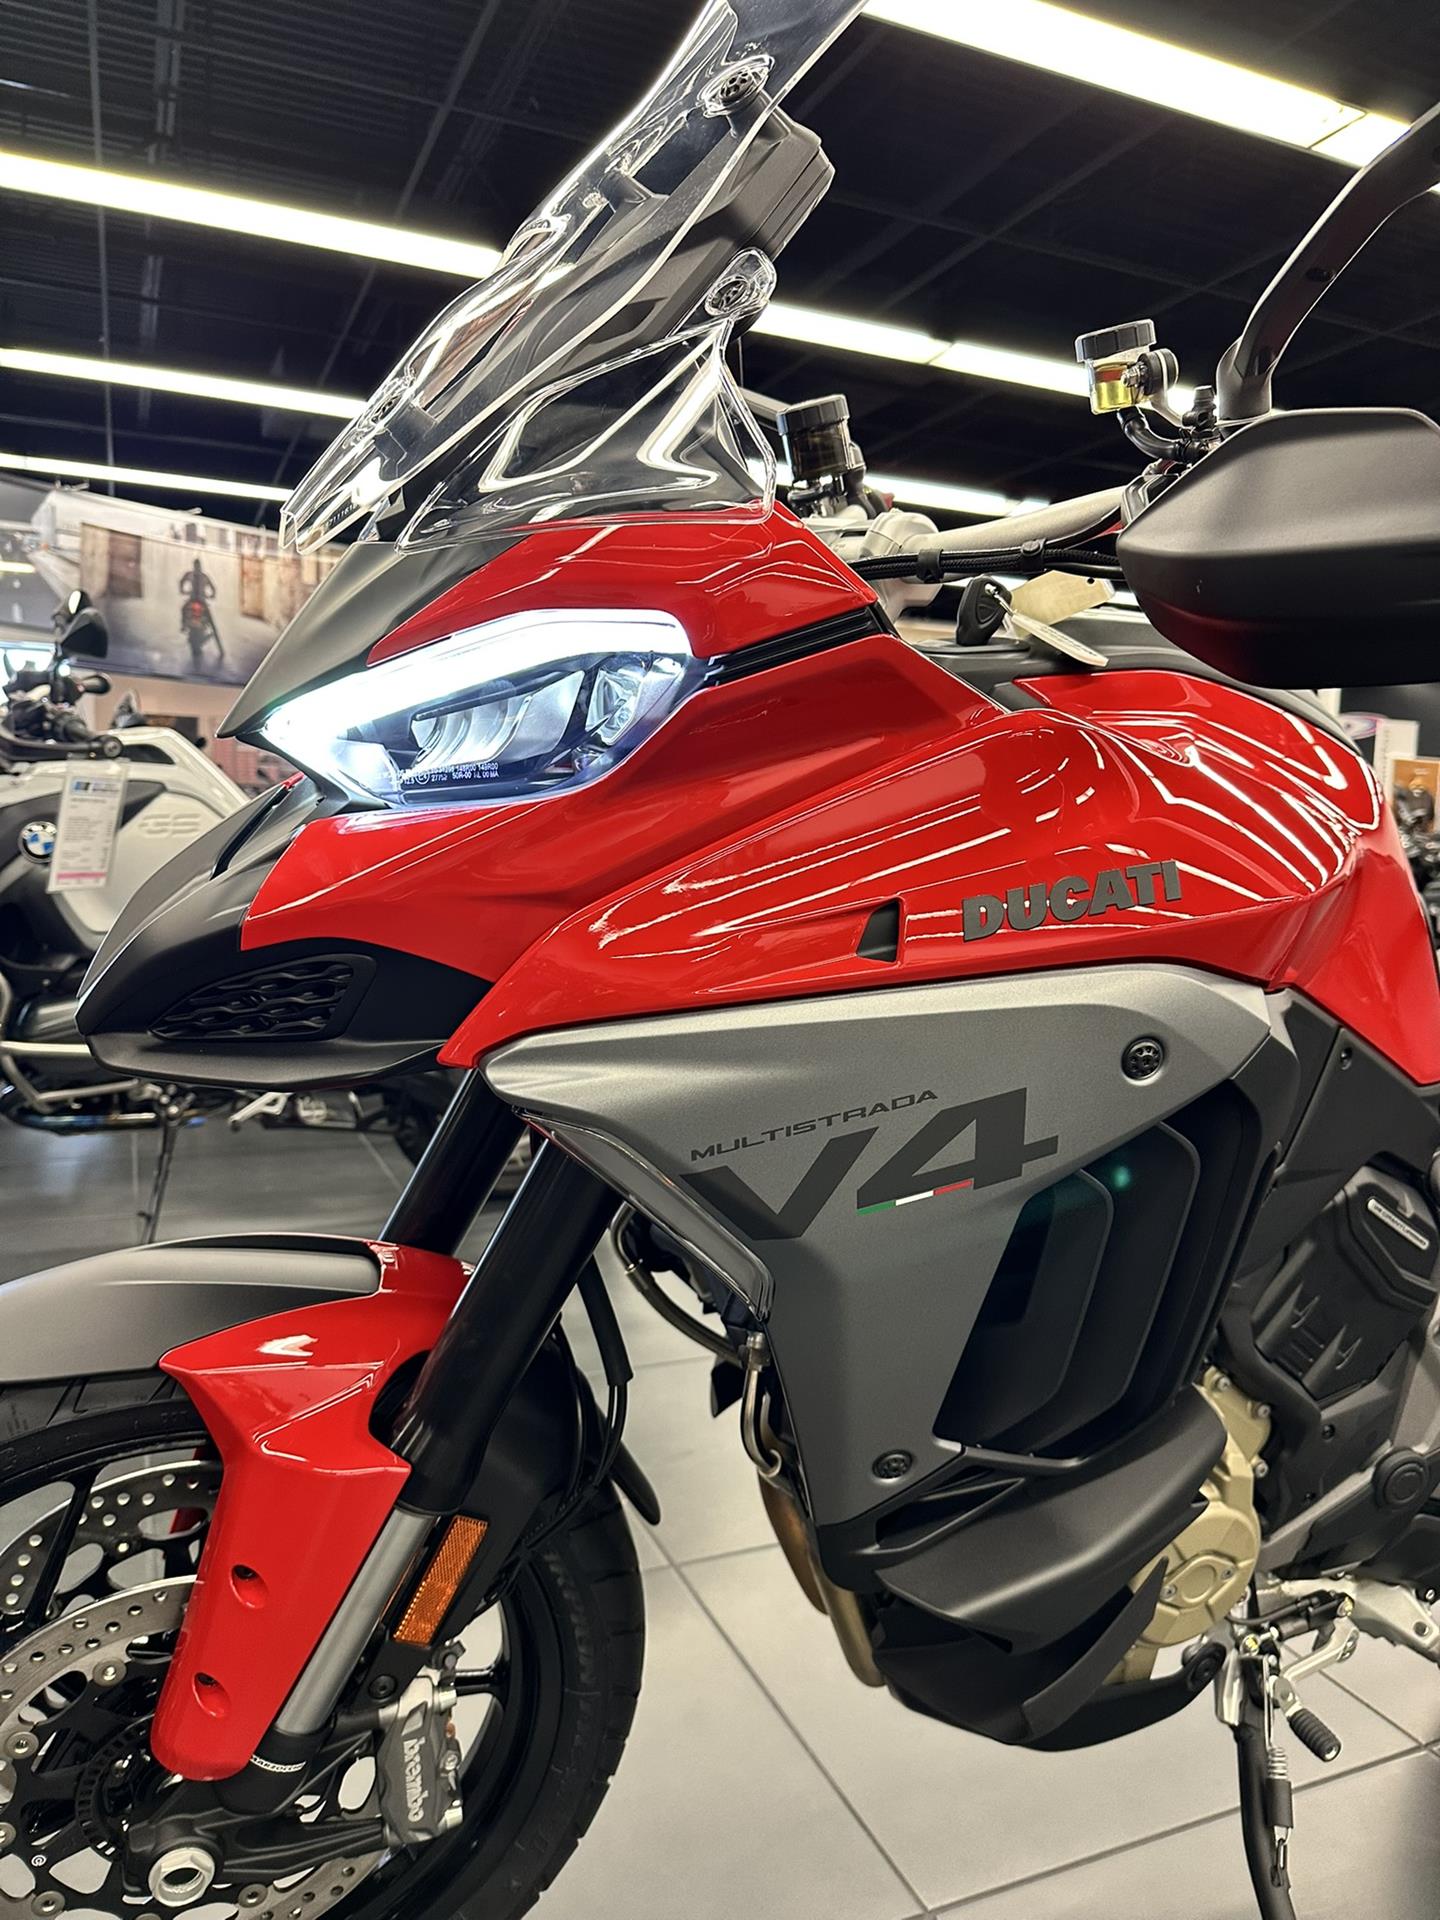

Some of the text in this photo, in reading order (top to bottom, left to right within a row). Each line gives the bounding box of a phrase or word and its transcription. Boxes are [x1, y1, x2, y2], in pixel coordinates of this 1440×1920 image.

[962, 860, 1182, 942] DUCATI
[679, 1087, 1059, 1241] V4
[690, 1089, 938, 1162] MULTISTRADA
[403, 1736, 429, 1822] brembo
